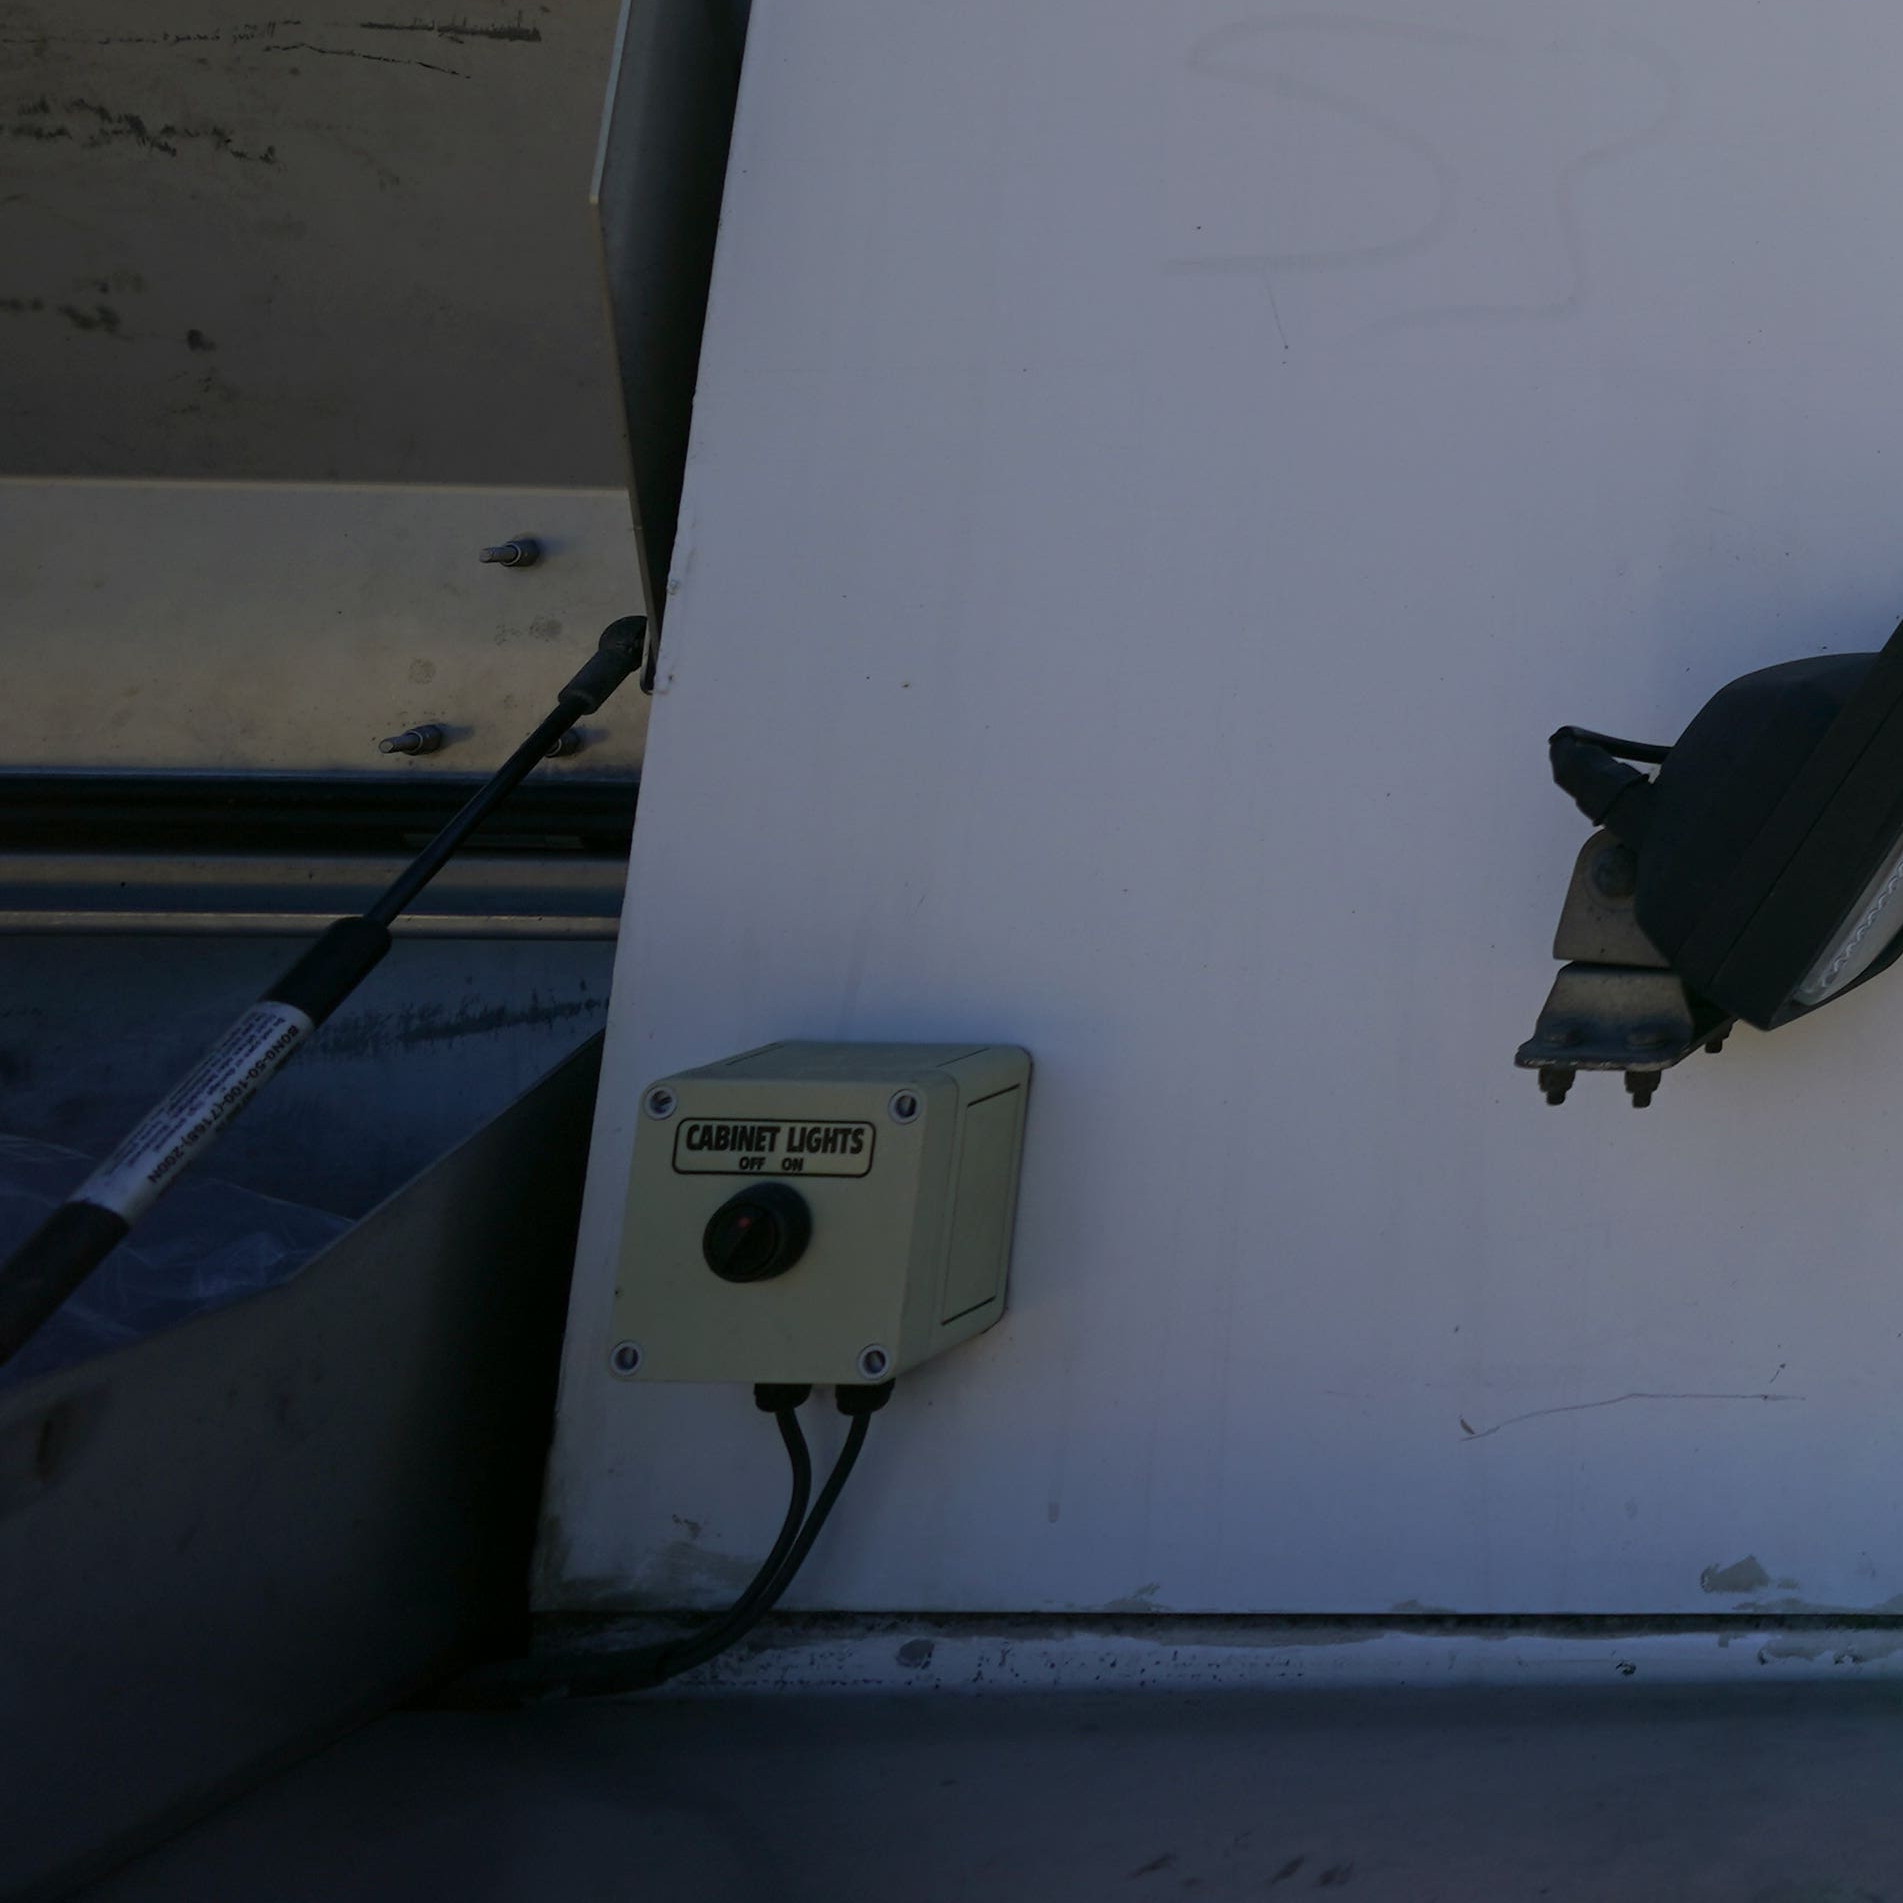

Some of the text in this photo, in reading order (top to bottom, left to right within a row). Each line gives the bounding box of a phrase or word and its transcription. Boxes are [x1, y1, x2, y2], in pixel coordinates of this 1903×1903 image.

[686, 1124, 865, 1154] CABINET LIGHTS
[739, 1156, 804, 1172] OFF ON
